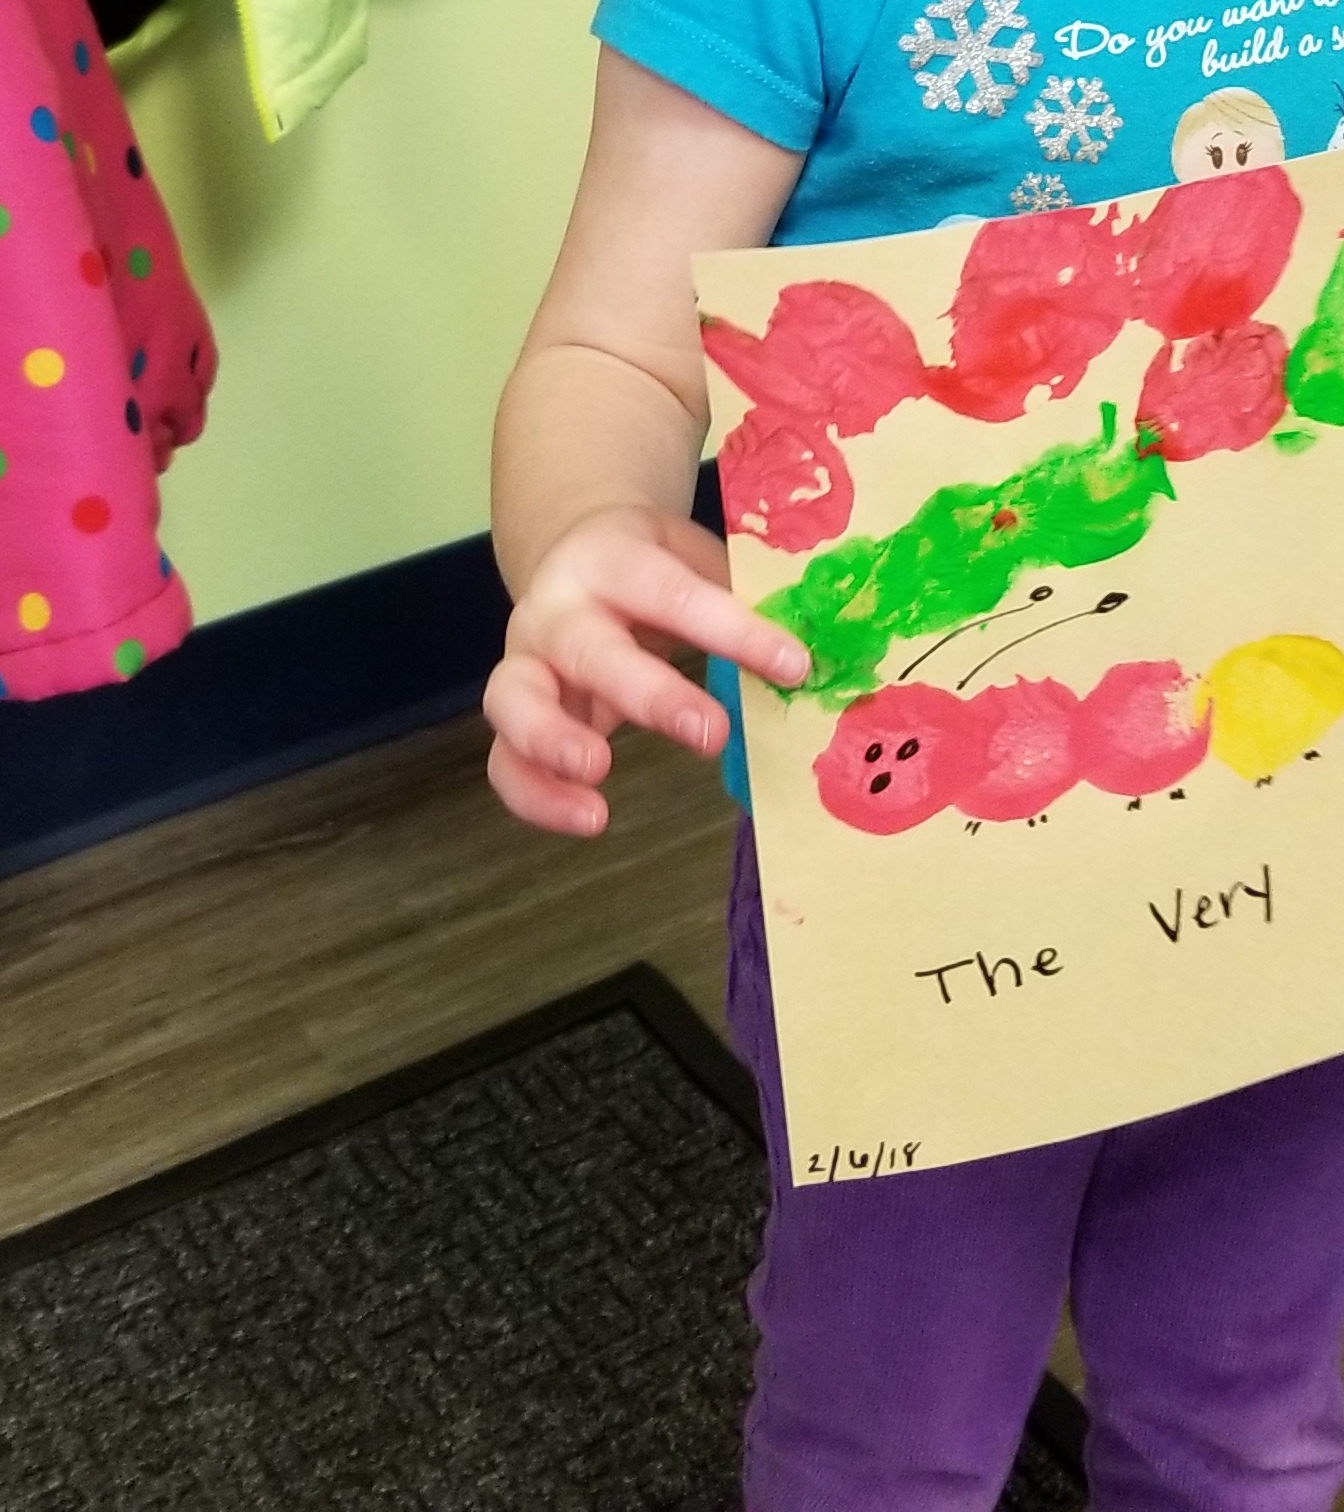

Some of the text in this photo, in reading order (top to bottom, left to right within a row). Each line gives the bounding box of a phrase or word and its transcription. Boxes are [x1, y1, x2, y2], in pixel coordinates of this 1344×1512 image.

[1054, 19, 1136, 61] Do
[1145, 16, 1214, 69] you
[1201, 26, 1290, 78] build
[1298, 33, 1323, 57] a
[914, 947, 1064, 1005] The
[1149, 864, 1273, 944] Very
[808, 1141, 922, 1181] 2/6/18
